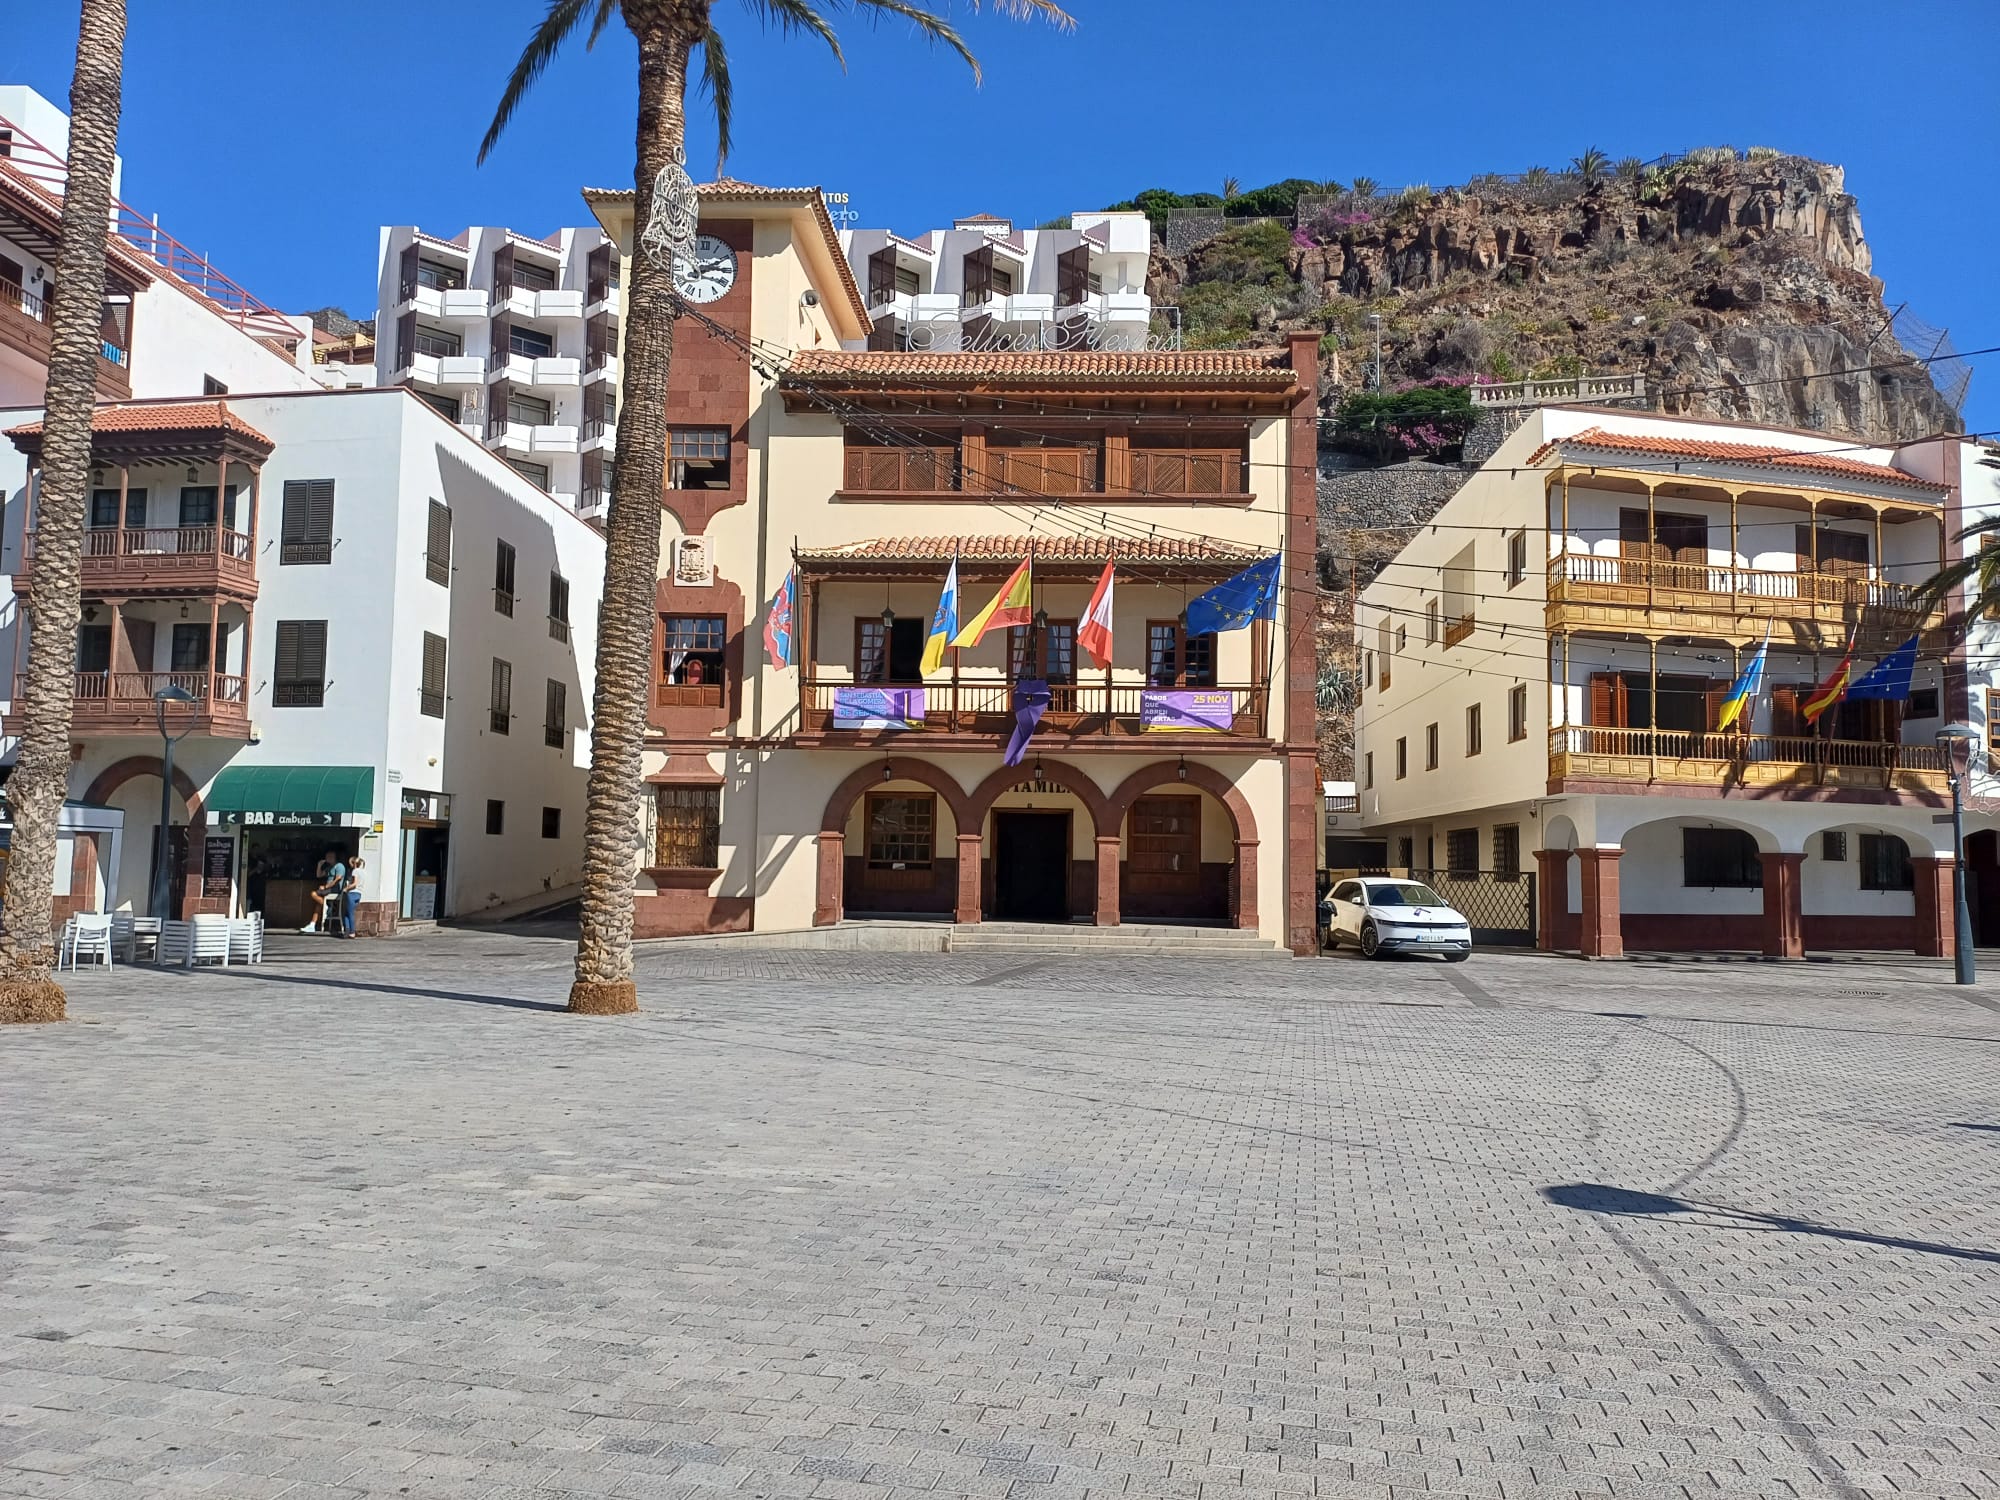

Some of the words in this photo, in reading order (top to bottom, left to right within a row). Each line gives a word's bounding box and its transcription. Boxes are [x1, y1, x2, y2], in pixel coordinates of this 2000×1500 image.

[830, 210, 859, 221] ero
[908, 312, 1036, 352] Felices
[1042, 310, 1179, 352] Fiestas
[1193, 695, 1206, 704] 25
[1207, 695, 1229, 704] NOV
[244, 811, 275, 825] BAR
